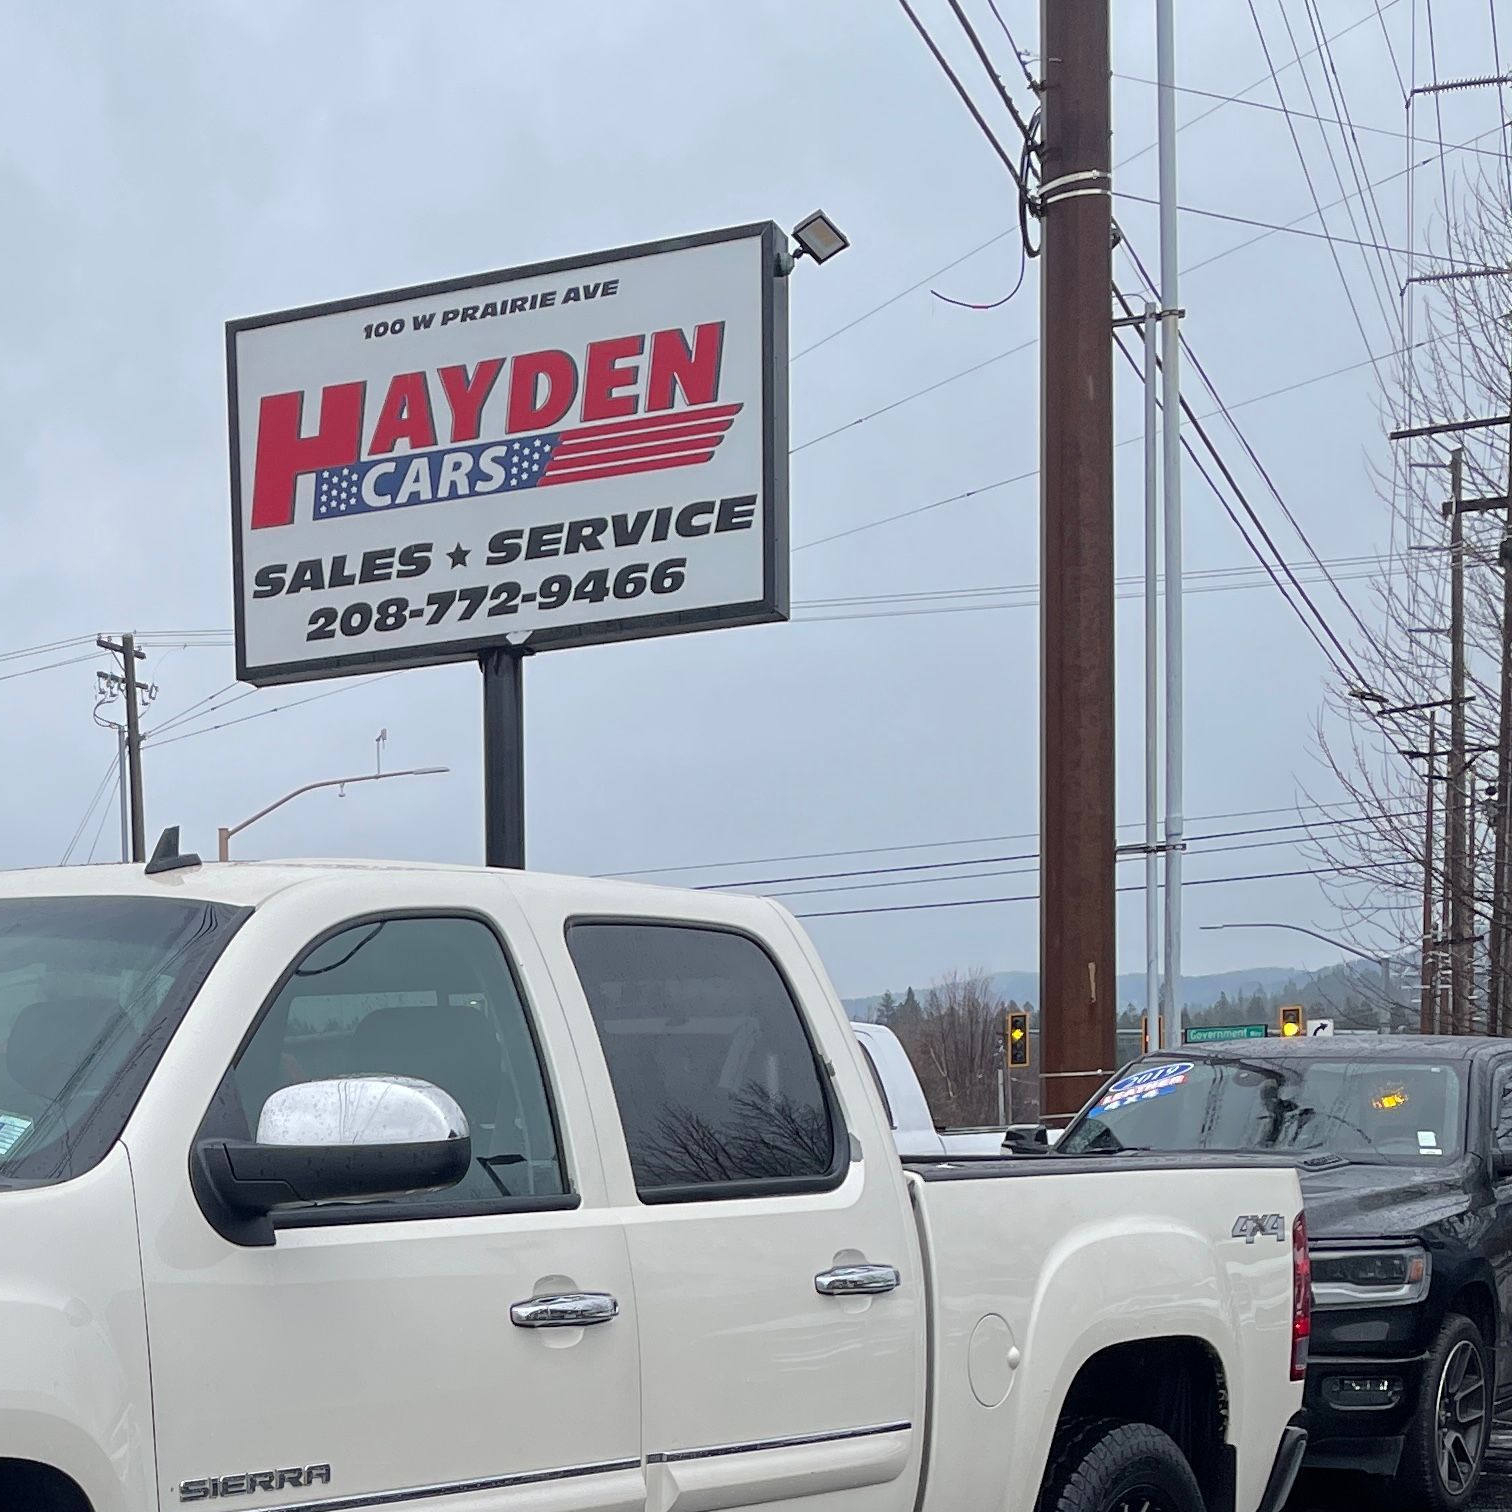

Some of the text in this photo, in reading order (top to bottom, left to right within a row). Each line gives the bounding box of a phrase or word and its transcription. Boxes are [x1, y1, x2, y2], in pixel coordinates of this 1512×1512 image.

[363, 279, 620, 340] 100 W PRAIRIE AVE
[251, 321, 726, 529] HAYDEN
[361, 444, 508, 508] CARS
[252, 494, 758, 599] SALES SERVICE
[306, 557, 688, 642] 208-772-9466
[1190, 1028, 1247, 1040] Government
[1125, 1065, 1180, 1089] 2019
[179, 1463, 331, 1502] SIERRA
